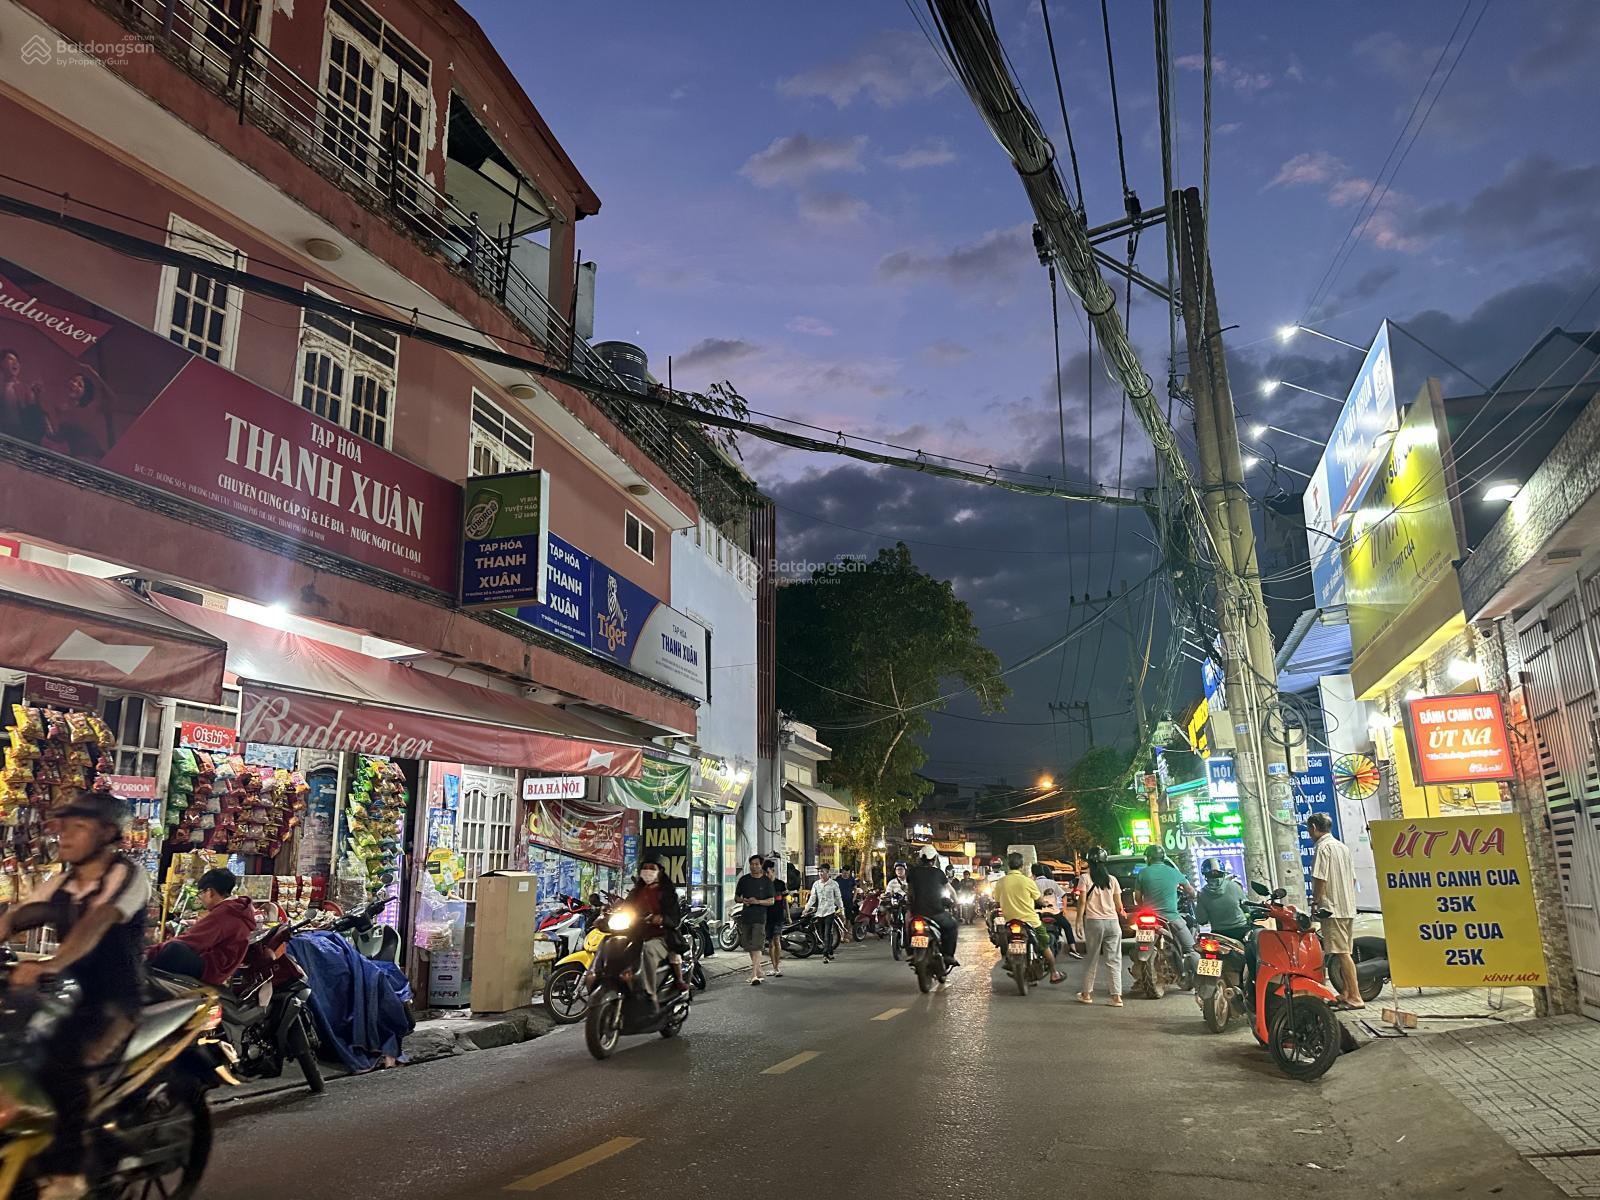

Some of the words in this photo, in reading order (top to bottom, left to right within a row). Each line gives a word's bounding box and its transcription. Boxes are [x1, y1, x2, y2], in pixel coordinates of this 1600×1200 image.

[0, 281, 97, 343] udweiser
[311, 422, 334, 449] TẠP
[337, 435, 362, 464] HÓA
[224, 412, 343, 507] THANH
[348, 469, 425, 541] XUÂN
[217, 473, 257, 500] CHUYÊN
[258, 489, 282, 511] CUNG
[283, 497, 301, 517] CẤP
[311, 512, 319, 525] &
[331, 518, 345, 535] BIA
[350, 526, 371, 545] NƯỚC
[371, 534, 392, 552] NGỌT
[392, 542, 406, 557] CÁC
[405, 547, 422, 564] LOẠI
[466, 506, 494, 534] TUBORG
[479, 543, 499, 554] TẠP
[500, 539, 523, 551] HÓA
[549, 542, 564, 561] TẠP
[564, 553, 580, 570] HÓA
[474, 553, 527, 569] THANH
[478, 571, 522, 588] XUÂN
[547, 564, 582, 597] THANH
[549, 592, 579, 621] XUÂN
[596, 612, 627, 652] Tiger
[661, 633, 682, 659] THANH
[682, 644, 698, 667] XUÂN
[45, 681, 78, 694] EURO
[240, 691, 434, 760] Budweiser
[1419, 709, 1447, 725] BÁNH
[1447, 707, 1473, 722] CANH
[1474, 706, 1495, 720] CUA
[193, 726, 223, 745] Oishi
[1428, 725, 1459, 749] ÚT
[1461, 726, 1492, 746] NA
[120, 783, 150, 793] ORION
[527, 784, 545, 795] BIA
[546, 781, 561, 794] HÀ
[561, 781, 581, 796] NỘI
[1310, 775, 1325, 785] LOAN
[1315, 791, 1327, 803] CẤP
[645, 827, 687, 848] NAM
[1391, 824, 1449, 859] ÚT
[1449, 827, 1506, 857] NA
[1386, 869, 1432, 889] BÁNH
[1436, 870, 1483, 888] CANH
[1486, 868, 1521, 887] CUA
[1436, 895, 1477, 913] 35K
[1418, 920, 1458, 941] SÚP
[1464, 922, 1505, 940] CUA
[1445, 948, 1486, 966] 25K
[1482, 972, 1513, 983] KÍNH
